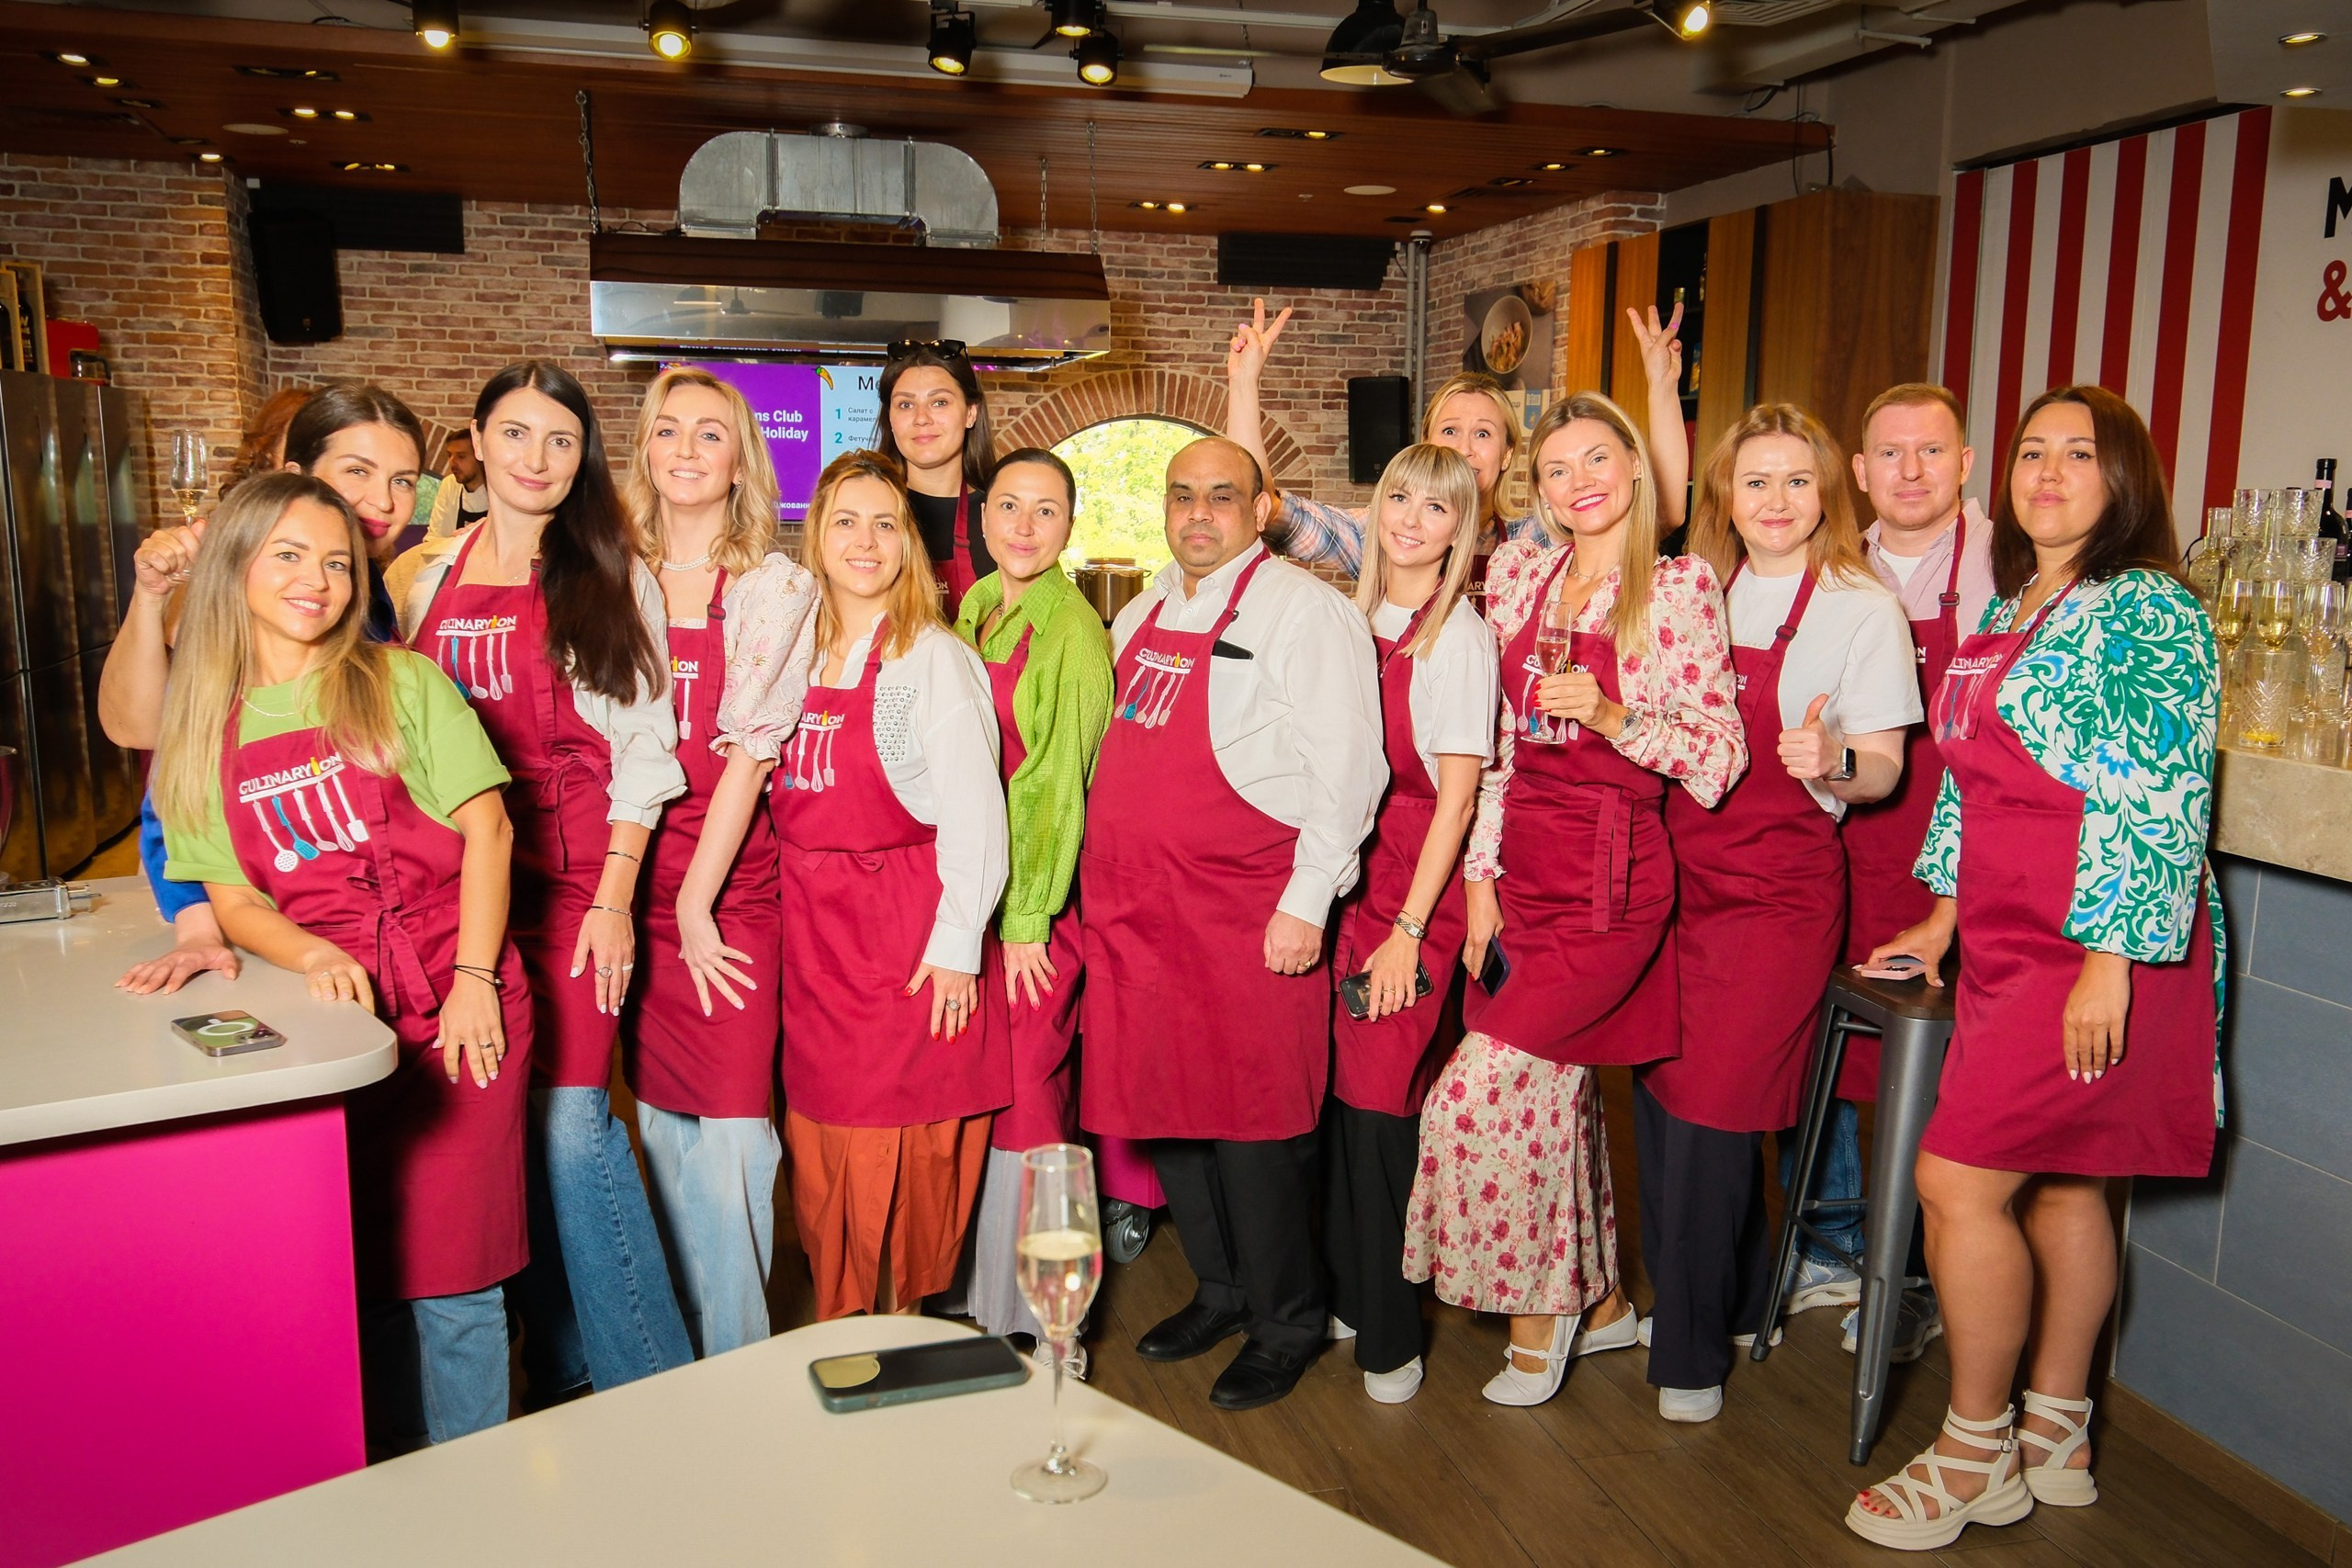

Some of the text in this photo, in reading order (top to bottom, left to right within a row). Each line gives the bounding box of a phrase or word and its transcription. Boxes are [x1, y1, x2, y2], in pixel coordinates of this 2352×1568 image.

[773, 410, 803, 423] Club
[835, 408, 841, 420] 1
[761, 426, 808, 442] Holiday
[834, 432, 842, 444] 2
